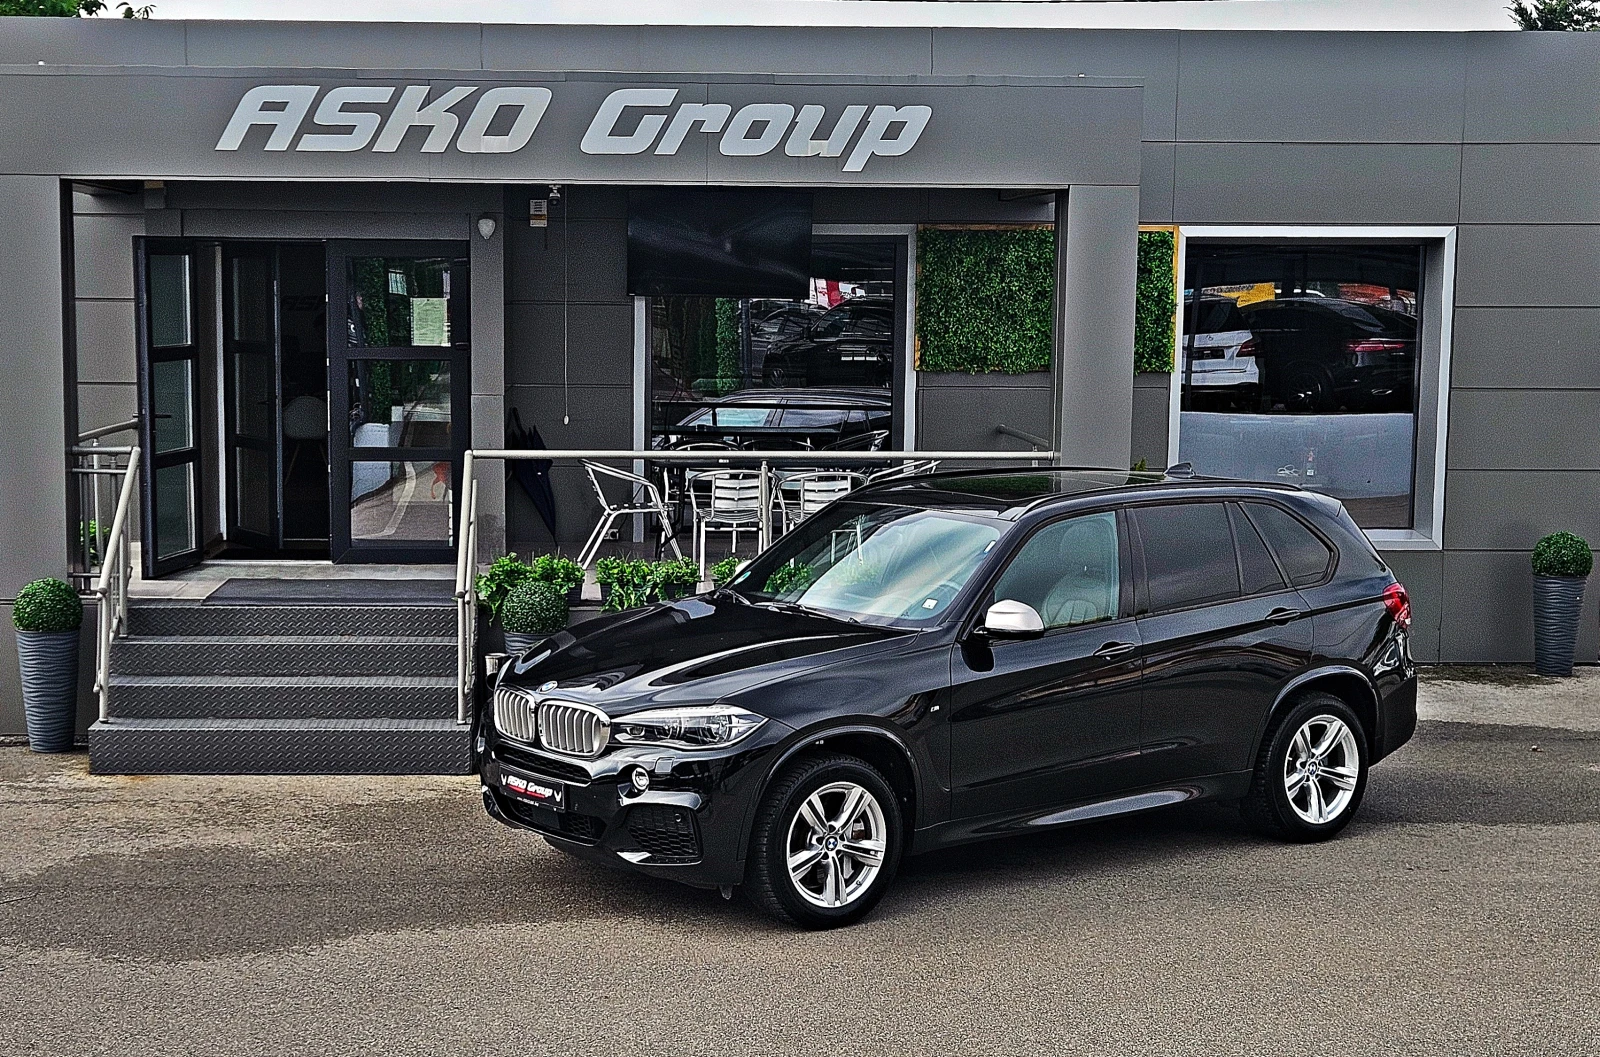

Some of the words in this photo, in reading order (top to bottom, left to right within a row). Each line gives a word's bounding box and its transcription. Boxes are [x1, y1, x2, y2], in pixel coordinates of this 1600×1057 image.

[214, 85, 552, 154] ASKO
[580, 88, 932, 172] Group
[507, 775, 528, 790] ASKO
[527, 782, 554, 798] Group
